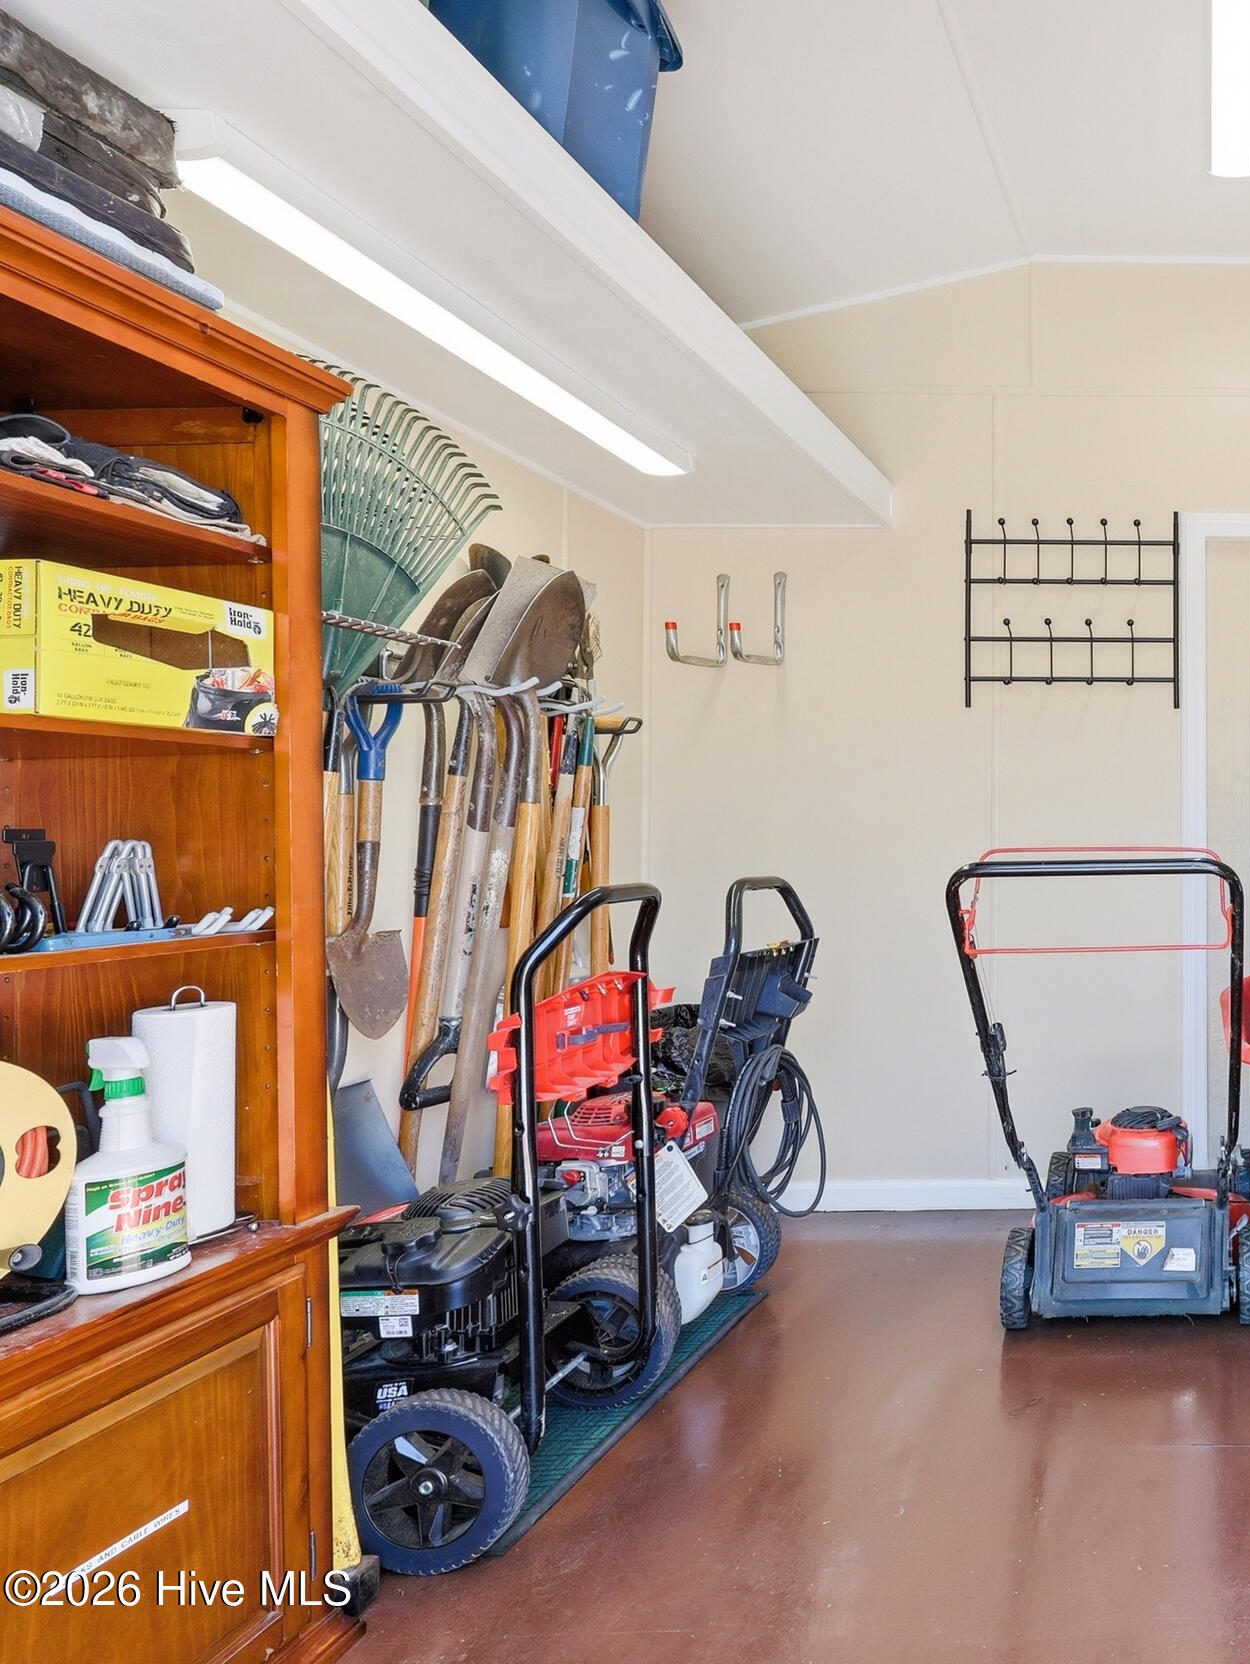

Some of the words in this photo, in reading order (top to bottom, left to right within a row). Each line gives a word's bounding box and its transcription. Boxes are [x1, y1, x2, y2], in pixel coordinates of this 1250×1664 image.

[14, 566, 24, 599] HEAVY
[57, 586, 124, 611] HEAVY
[127, 599, 173, 619] DUTY
[13, 603, 22, 629] DUTY
[229, 607, 253, 621] Iron-
[69, 622, 93, 638] 42
[230, 617, 252, 630] Hold
[115, 1194, 185, 1232] Nine
[1127, 1228, 1159, 1236] DANGER
[377, 1385, 408, 1400] USA
